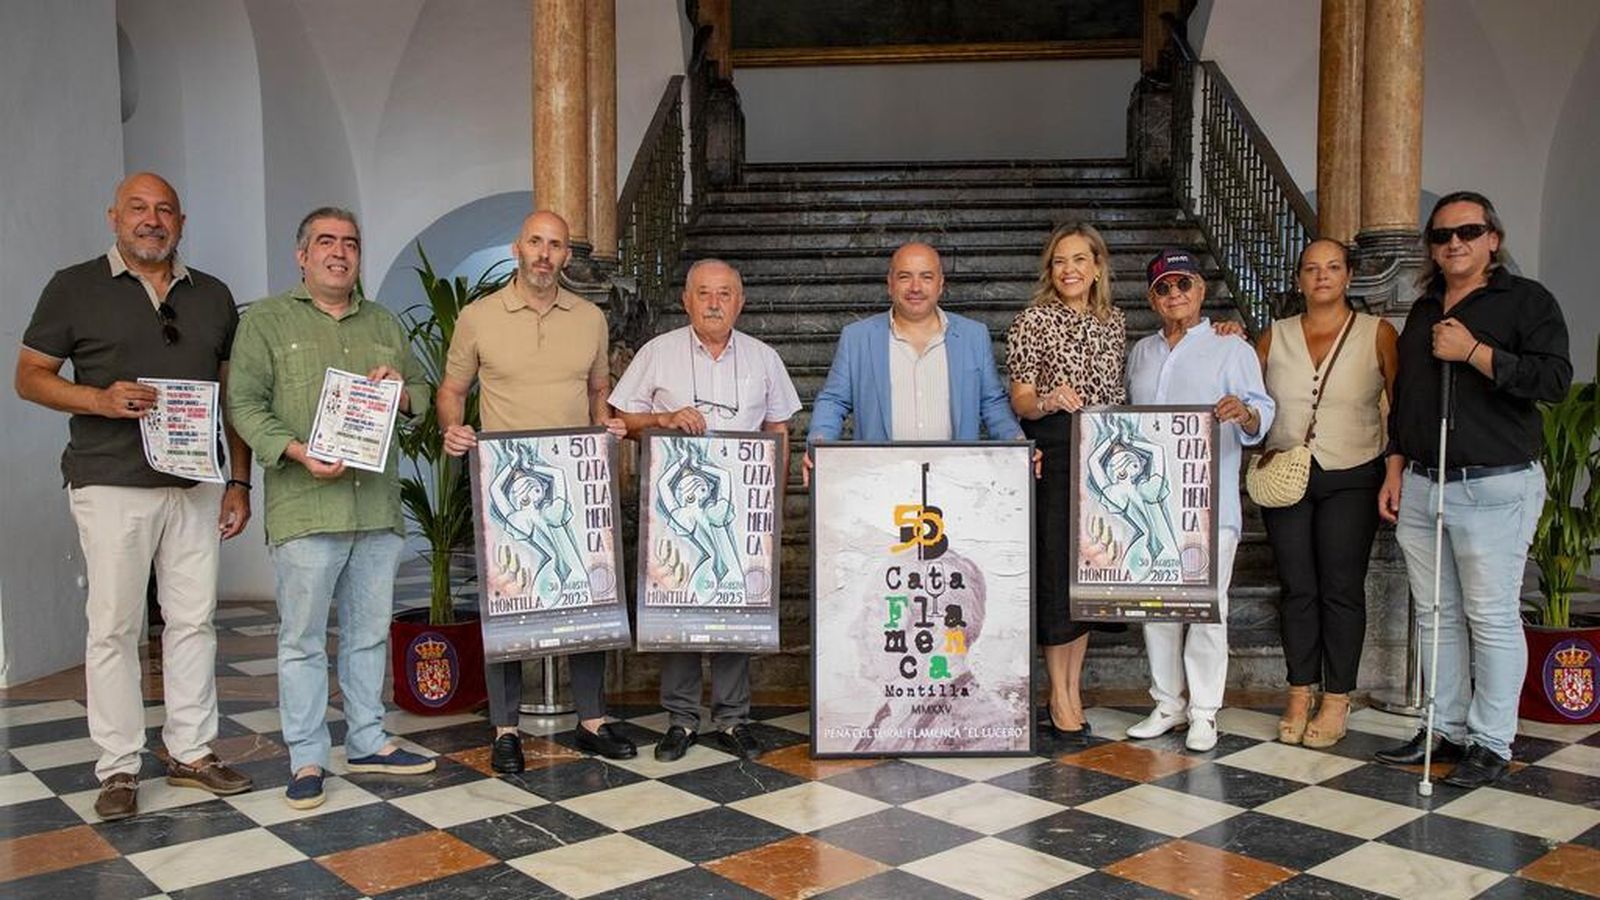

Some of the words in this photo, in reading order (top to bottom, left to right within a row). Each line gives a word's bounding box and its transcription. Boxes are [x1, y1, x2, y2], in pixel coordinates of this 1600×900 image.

[1171, 415, 1199, 435] 50
[570, 436, 597, 458] 50
[738, 441, 764, 462] 50
[1177, 438, 1210, 460] CATA
[577, 459, 610, 482] CATA
[743, 465, 774, 486] CATA
[1182, 462, 1210, 485] FLA
[584, 484, 612, 505] FLA
[748, 487, 774, 509] FLA
[1182, 487, 1209, 508] MEN
[585, 507, 612, 529] MEN
[747, 512, 774, 532] MEN
[1182, 512, 1200, 532] CA
[586, 532, 604, 553] CA
[746, 535, 763, 556] CA
[885, 565, 966, 591] Cata
[1080, 568, 1132, 581] MONTILLA
[1150, 569, 1179, 582] 2025
[490, 596, 544, 613] MONTILLA
[561, 592, 589, 606] 2025
[647, 590, 699, 604] MONTILLA
[716, 591, 743, 604] 2025
[883, 596, 967, 628] Fla
[884, 628, 967, 655] men
[899, 655, 951, 679] ca
[885, 684, 970, 698] Montilla
[911, 703, 952, 714] MMXXV
[906, 727, 961, 738] FLAMENCA
